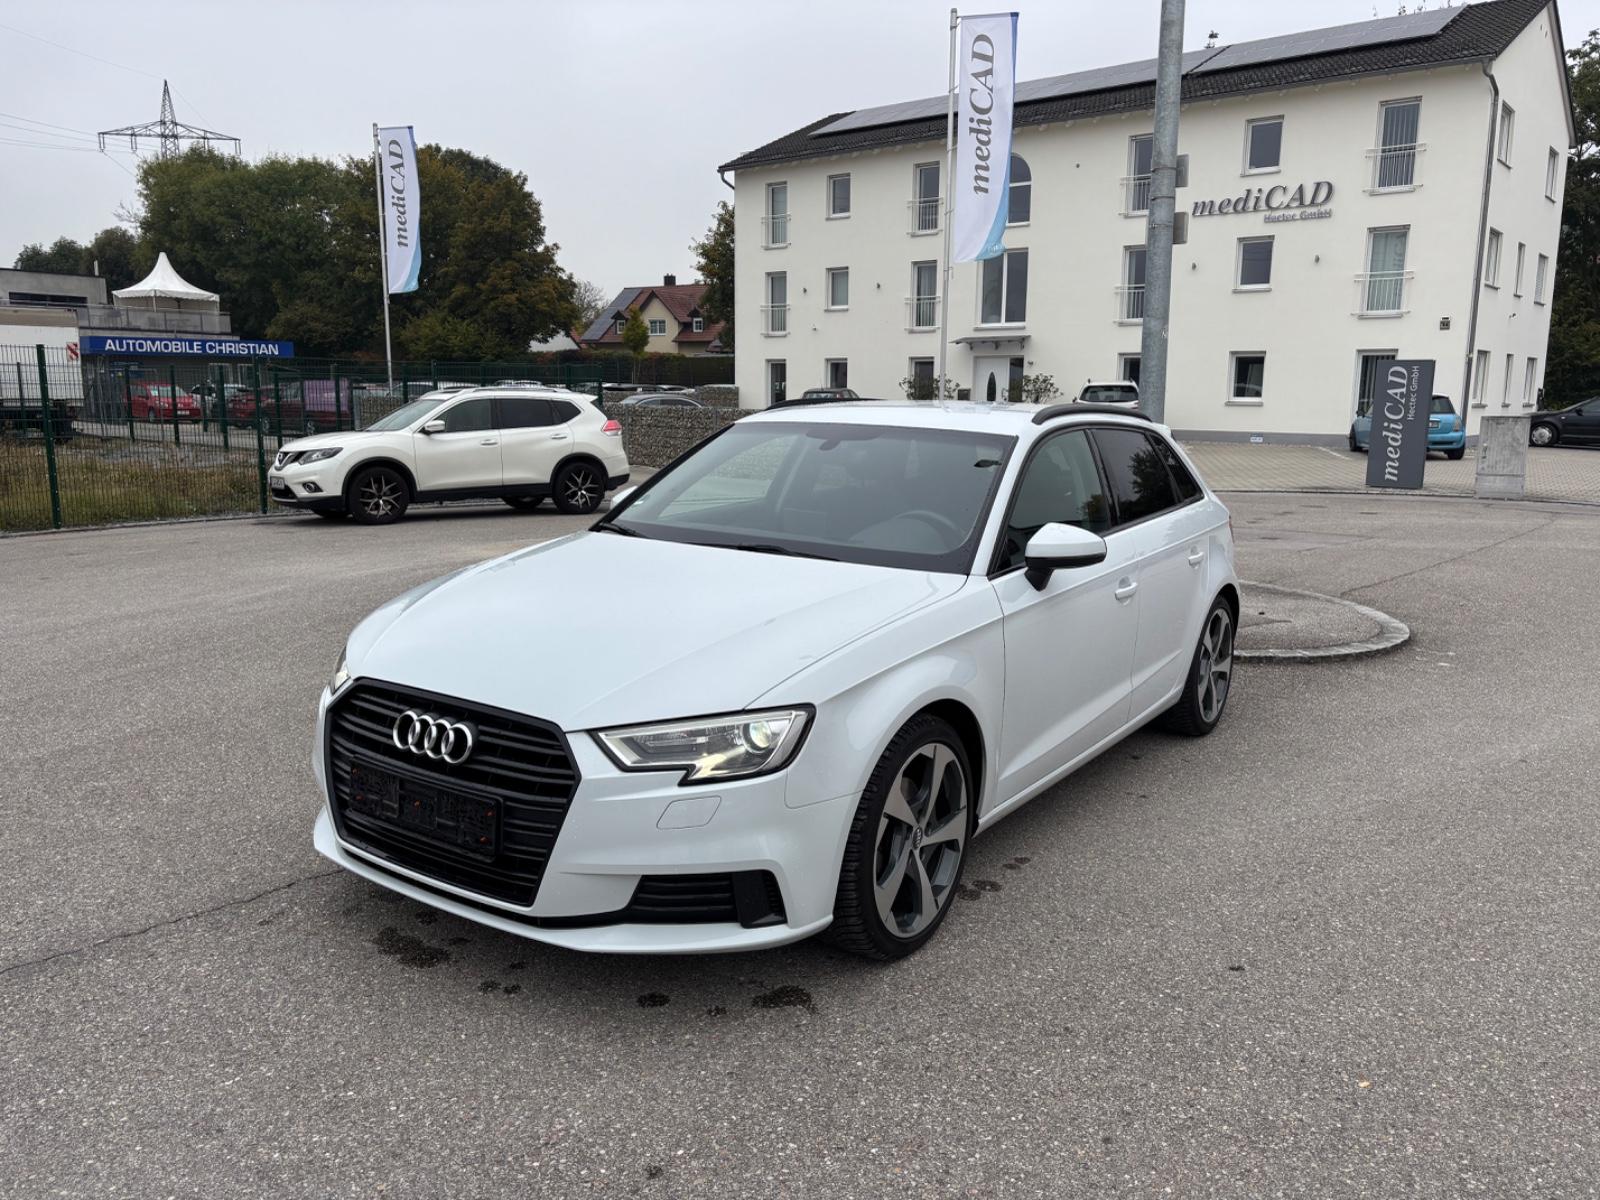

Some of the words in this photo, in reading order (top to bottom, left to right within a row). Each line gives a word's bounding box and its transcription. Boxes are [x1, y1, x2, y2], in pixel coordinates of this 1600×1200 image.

[969, 33, 995, 196] mediCAD
[388, 139, 409, 248] mediCAD
[1192, 181, 1334, 217] mediCAD
[104, 339, 202, 353] AUTOMOBILE
[205, 342, 279, 356] CHRISTIAN
[1410, 365, 1420, 391] GmbH
[1382, 365, 1408, 482] mediCAD
[1406, 393, 1417, 421] Hectec
